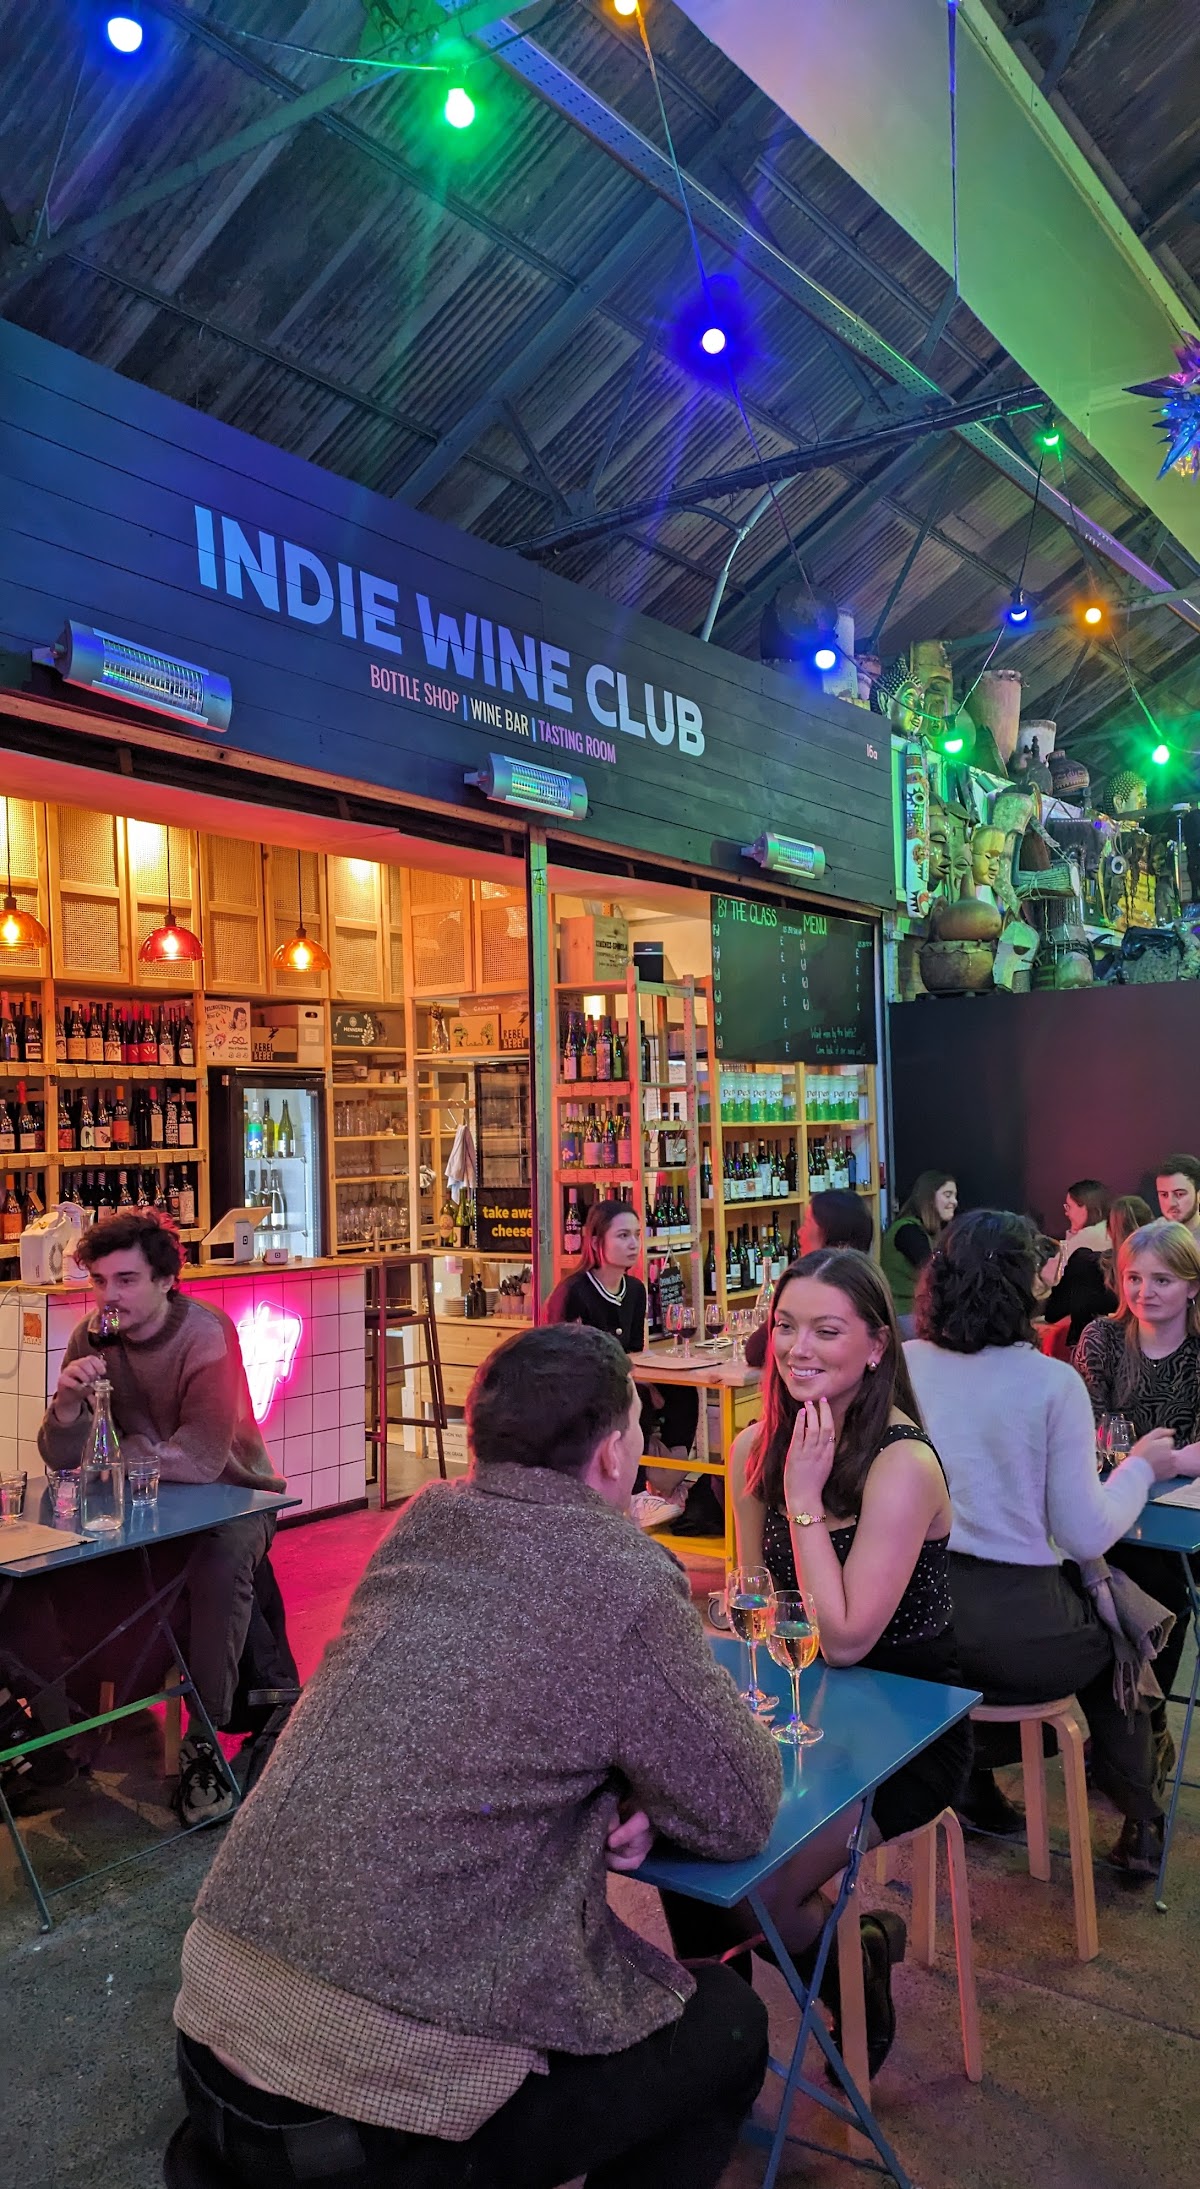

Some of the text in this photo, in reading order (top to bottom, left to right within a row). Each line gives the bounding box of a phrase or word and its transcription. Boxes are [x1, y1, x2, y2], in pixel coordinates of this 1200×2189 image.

[194, 505, 706, 757] INDIE WINE CLUB
[370, 664, 617, 765] BOTTLE SHOP WINE BAR TASTING ROOM
[866, 743, 878, 760] 16a
[717, 898, 727, 918] BY
[731, 900, 747, 922] THE
[803, 914, 827, 936] MENU
[503, 1029, 525, 1039] REBEL
[254, 1043, 274, 1052] REBEL
[482, 1206, 533, 1219] take awa
[491, 1224, 533, 1238] cheese
